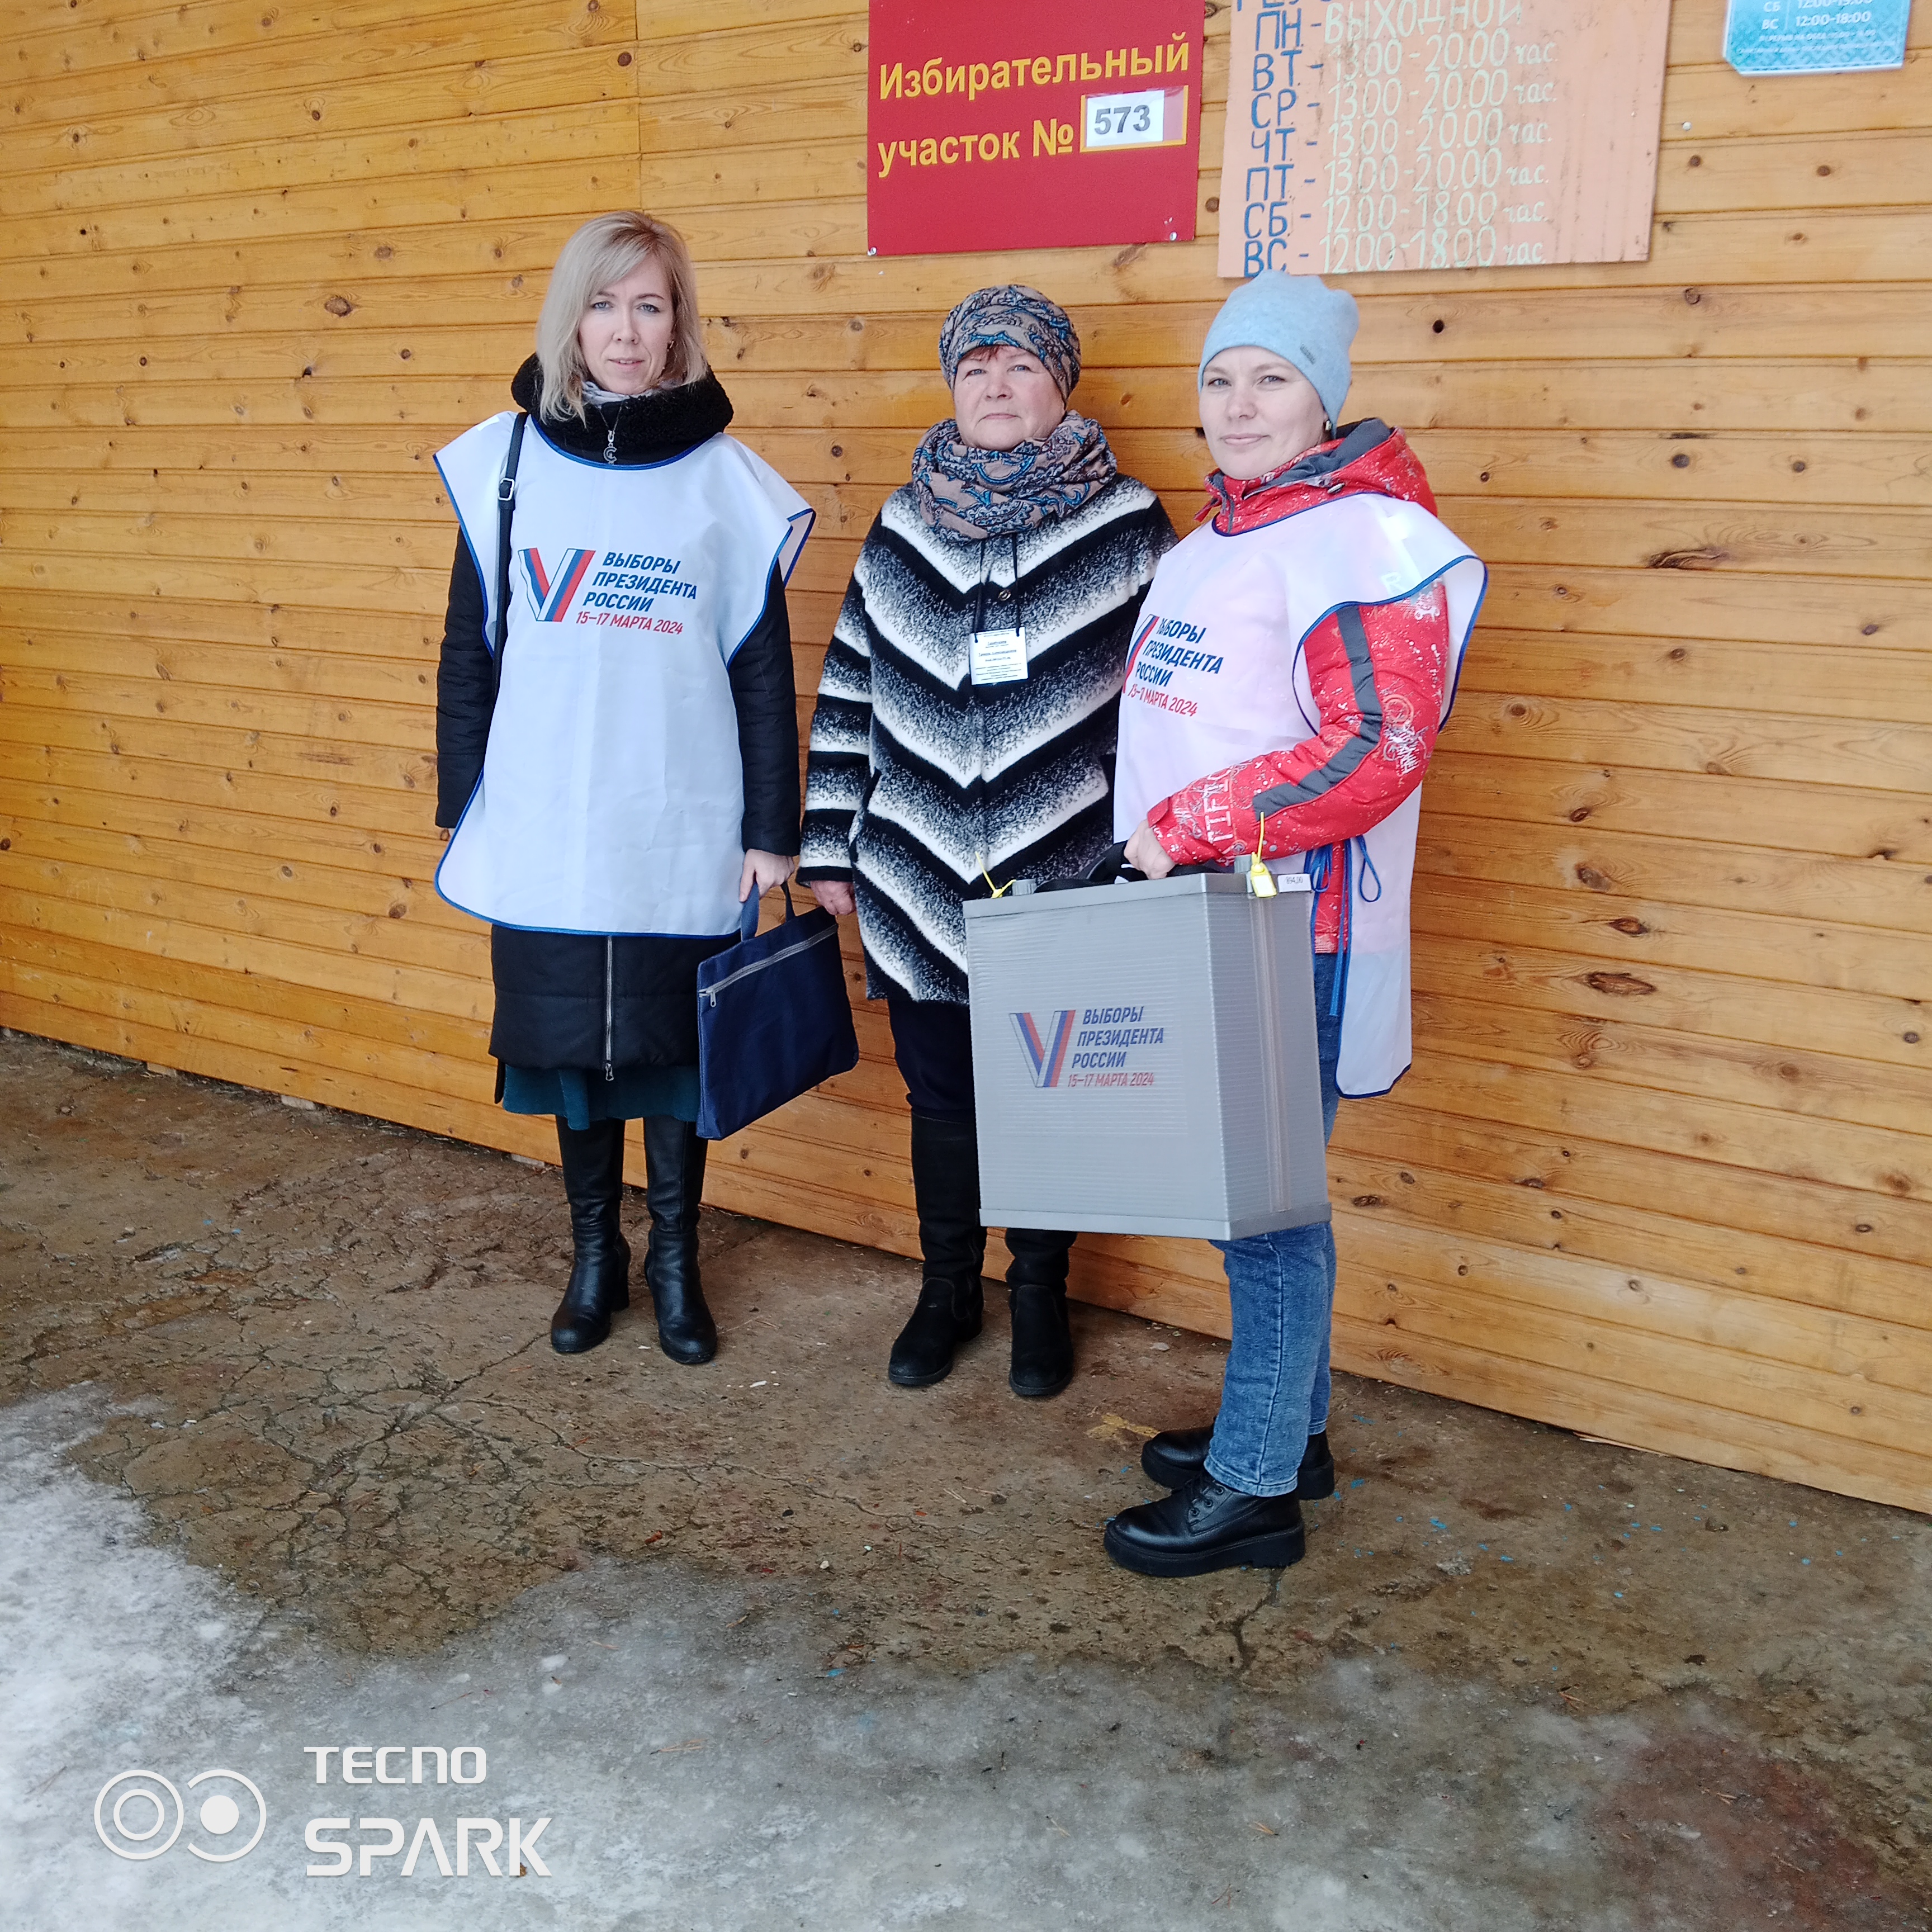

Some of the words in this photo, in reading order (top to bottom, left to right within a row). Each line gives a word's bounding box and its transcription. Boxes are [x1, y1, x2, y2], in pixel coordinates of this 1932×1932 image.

[1763, 1, 1781, 12] СБ
[1761, 18, 1779, 30] ВС
[1796, 11, 1871, 27] 12:00-18:00
[879, 31, 1190, 101] Избирательный
[877, 131, 1021, 178] участок
[1033, 118, 1074, 157] №
[1094, 104, 1151, 135] 573
[602, 552, 681, 574] ВЫБОРЫ
[592, 572, 698, 599] ПРЕЗИДЕНТА
[583, 591, 654, 612] РОССИИ
[610, 614, 650, 630] МАРТА
[653, 619, 683, 634] 2024
[1135, 661, 1173, 687] РОССИИ
[1168, 697, 1198, 717] 2024
[1083, 1006, 1144, 1025] ВЫБОРЫ
[1077, 1027, 1164, 1047] ПРЕЗИДЕНТА
[1072, 1052, 1126, 1068] РОССИИ
[1095, 1073, 1128, 1087] МАРТА
[1129, 1072, 1154, 1086] 2024
